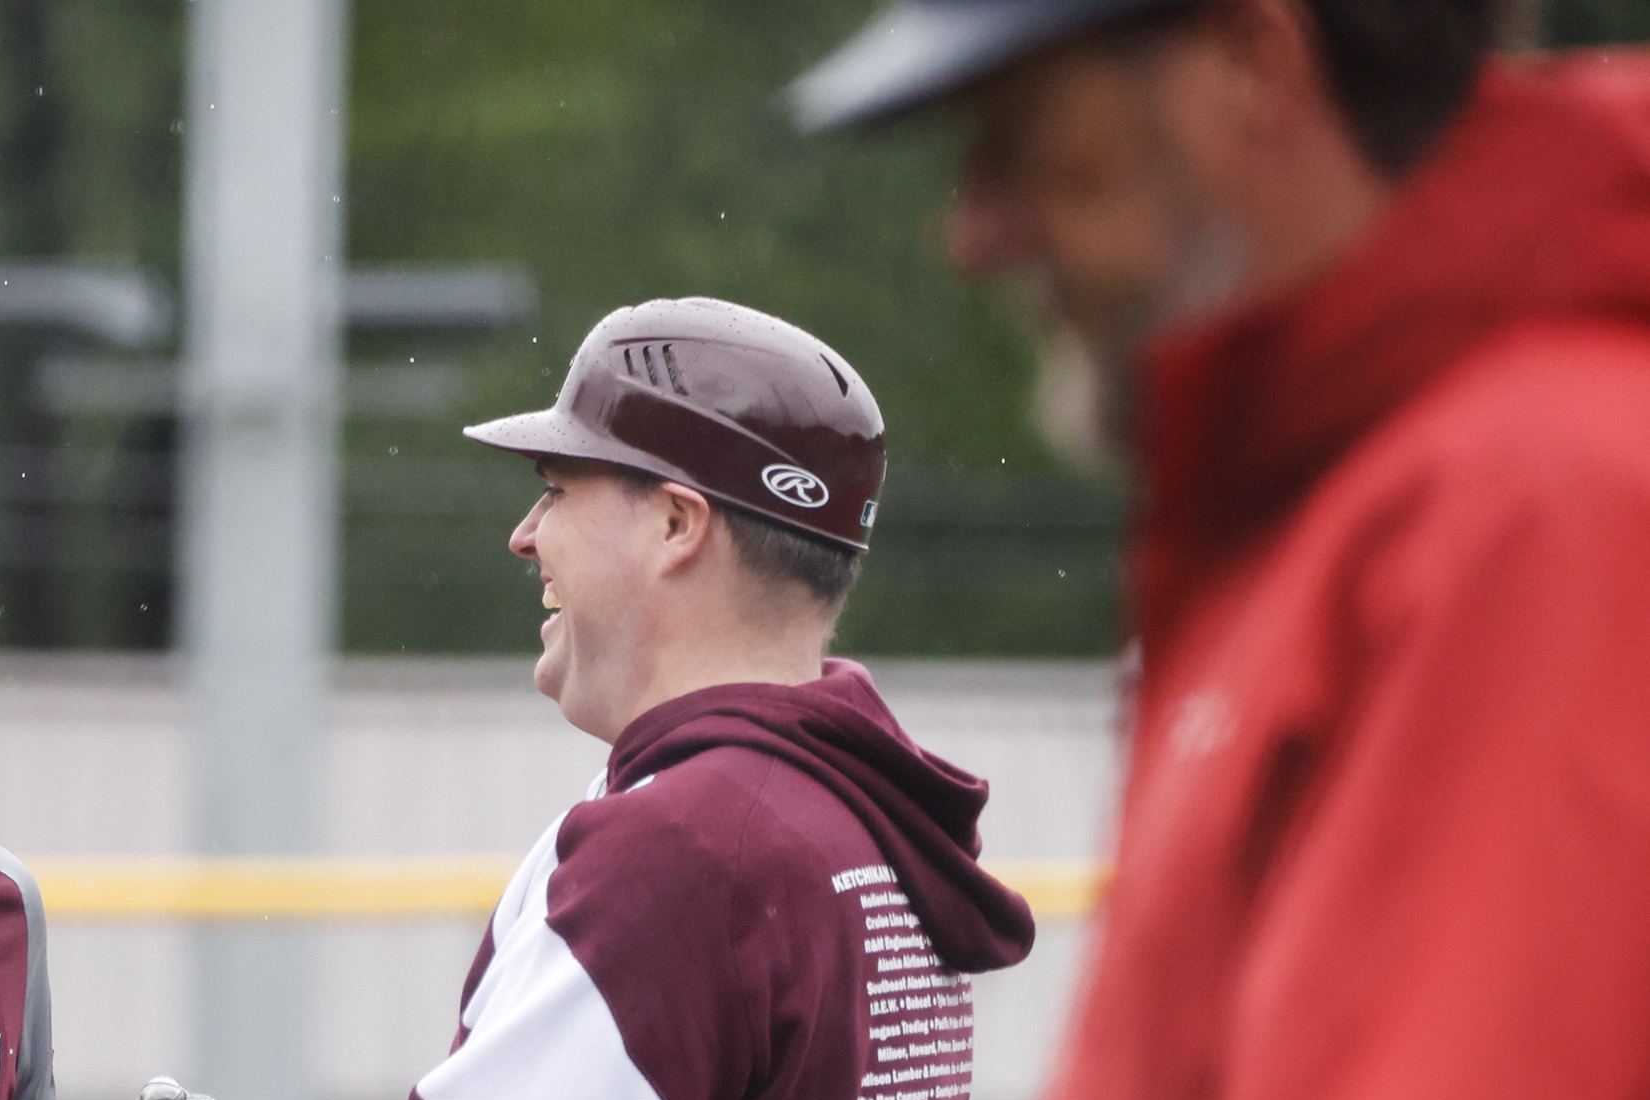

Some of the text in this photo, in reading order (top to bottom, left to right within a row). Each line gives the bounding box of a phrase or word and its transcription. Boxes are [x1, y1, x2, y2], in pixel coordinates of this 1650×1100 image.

[831, 865, 892, 893] KETCHIKAN
[877, 958, 903, 973] Alaska
[866, 977, 906, 996] Southeast
[907, 976, 931, 990] Alaska
[901, 1020, 929, 1036] Trading
[892, 1067, 923, 1084] Lumber
